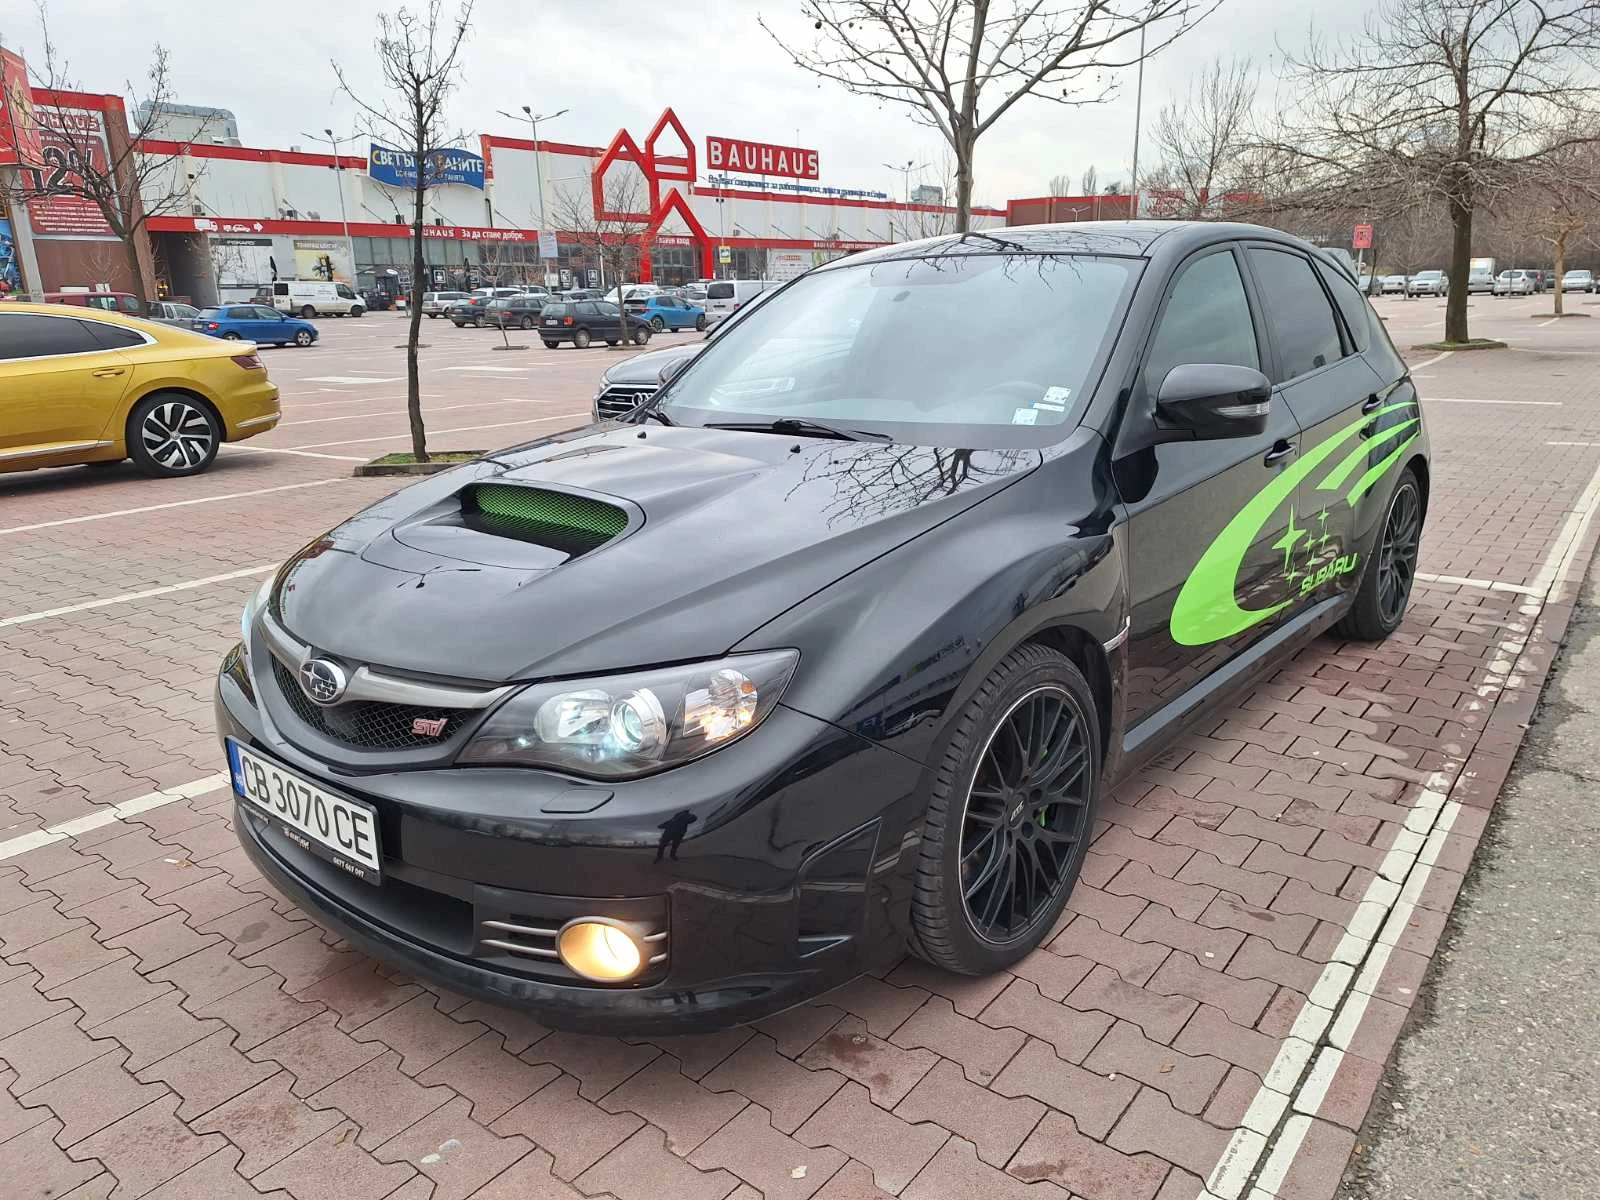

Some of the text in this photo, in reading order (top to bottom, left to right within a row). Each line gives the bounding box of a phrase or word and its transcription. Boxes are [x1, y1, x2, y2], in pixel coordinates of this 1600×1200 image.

[36, 113, 97, 129] UHAUS
[710, 141, 818, 175] BAUHAUS
[410, 229, 455, 238] BUHAUS
[462, 229, 470, 238] За
[471, 231, 481, 239] да
[482, 231, 501, 239] стане
[1299, 552, 1358, 597] SUBARU
[242, 755, 271, 804] CB
[272, 772, 329, 838] 3070
[333, 804, 373, 861] CE
